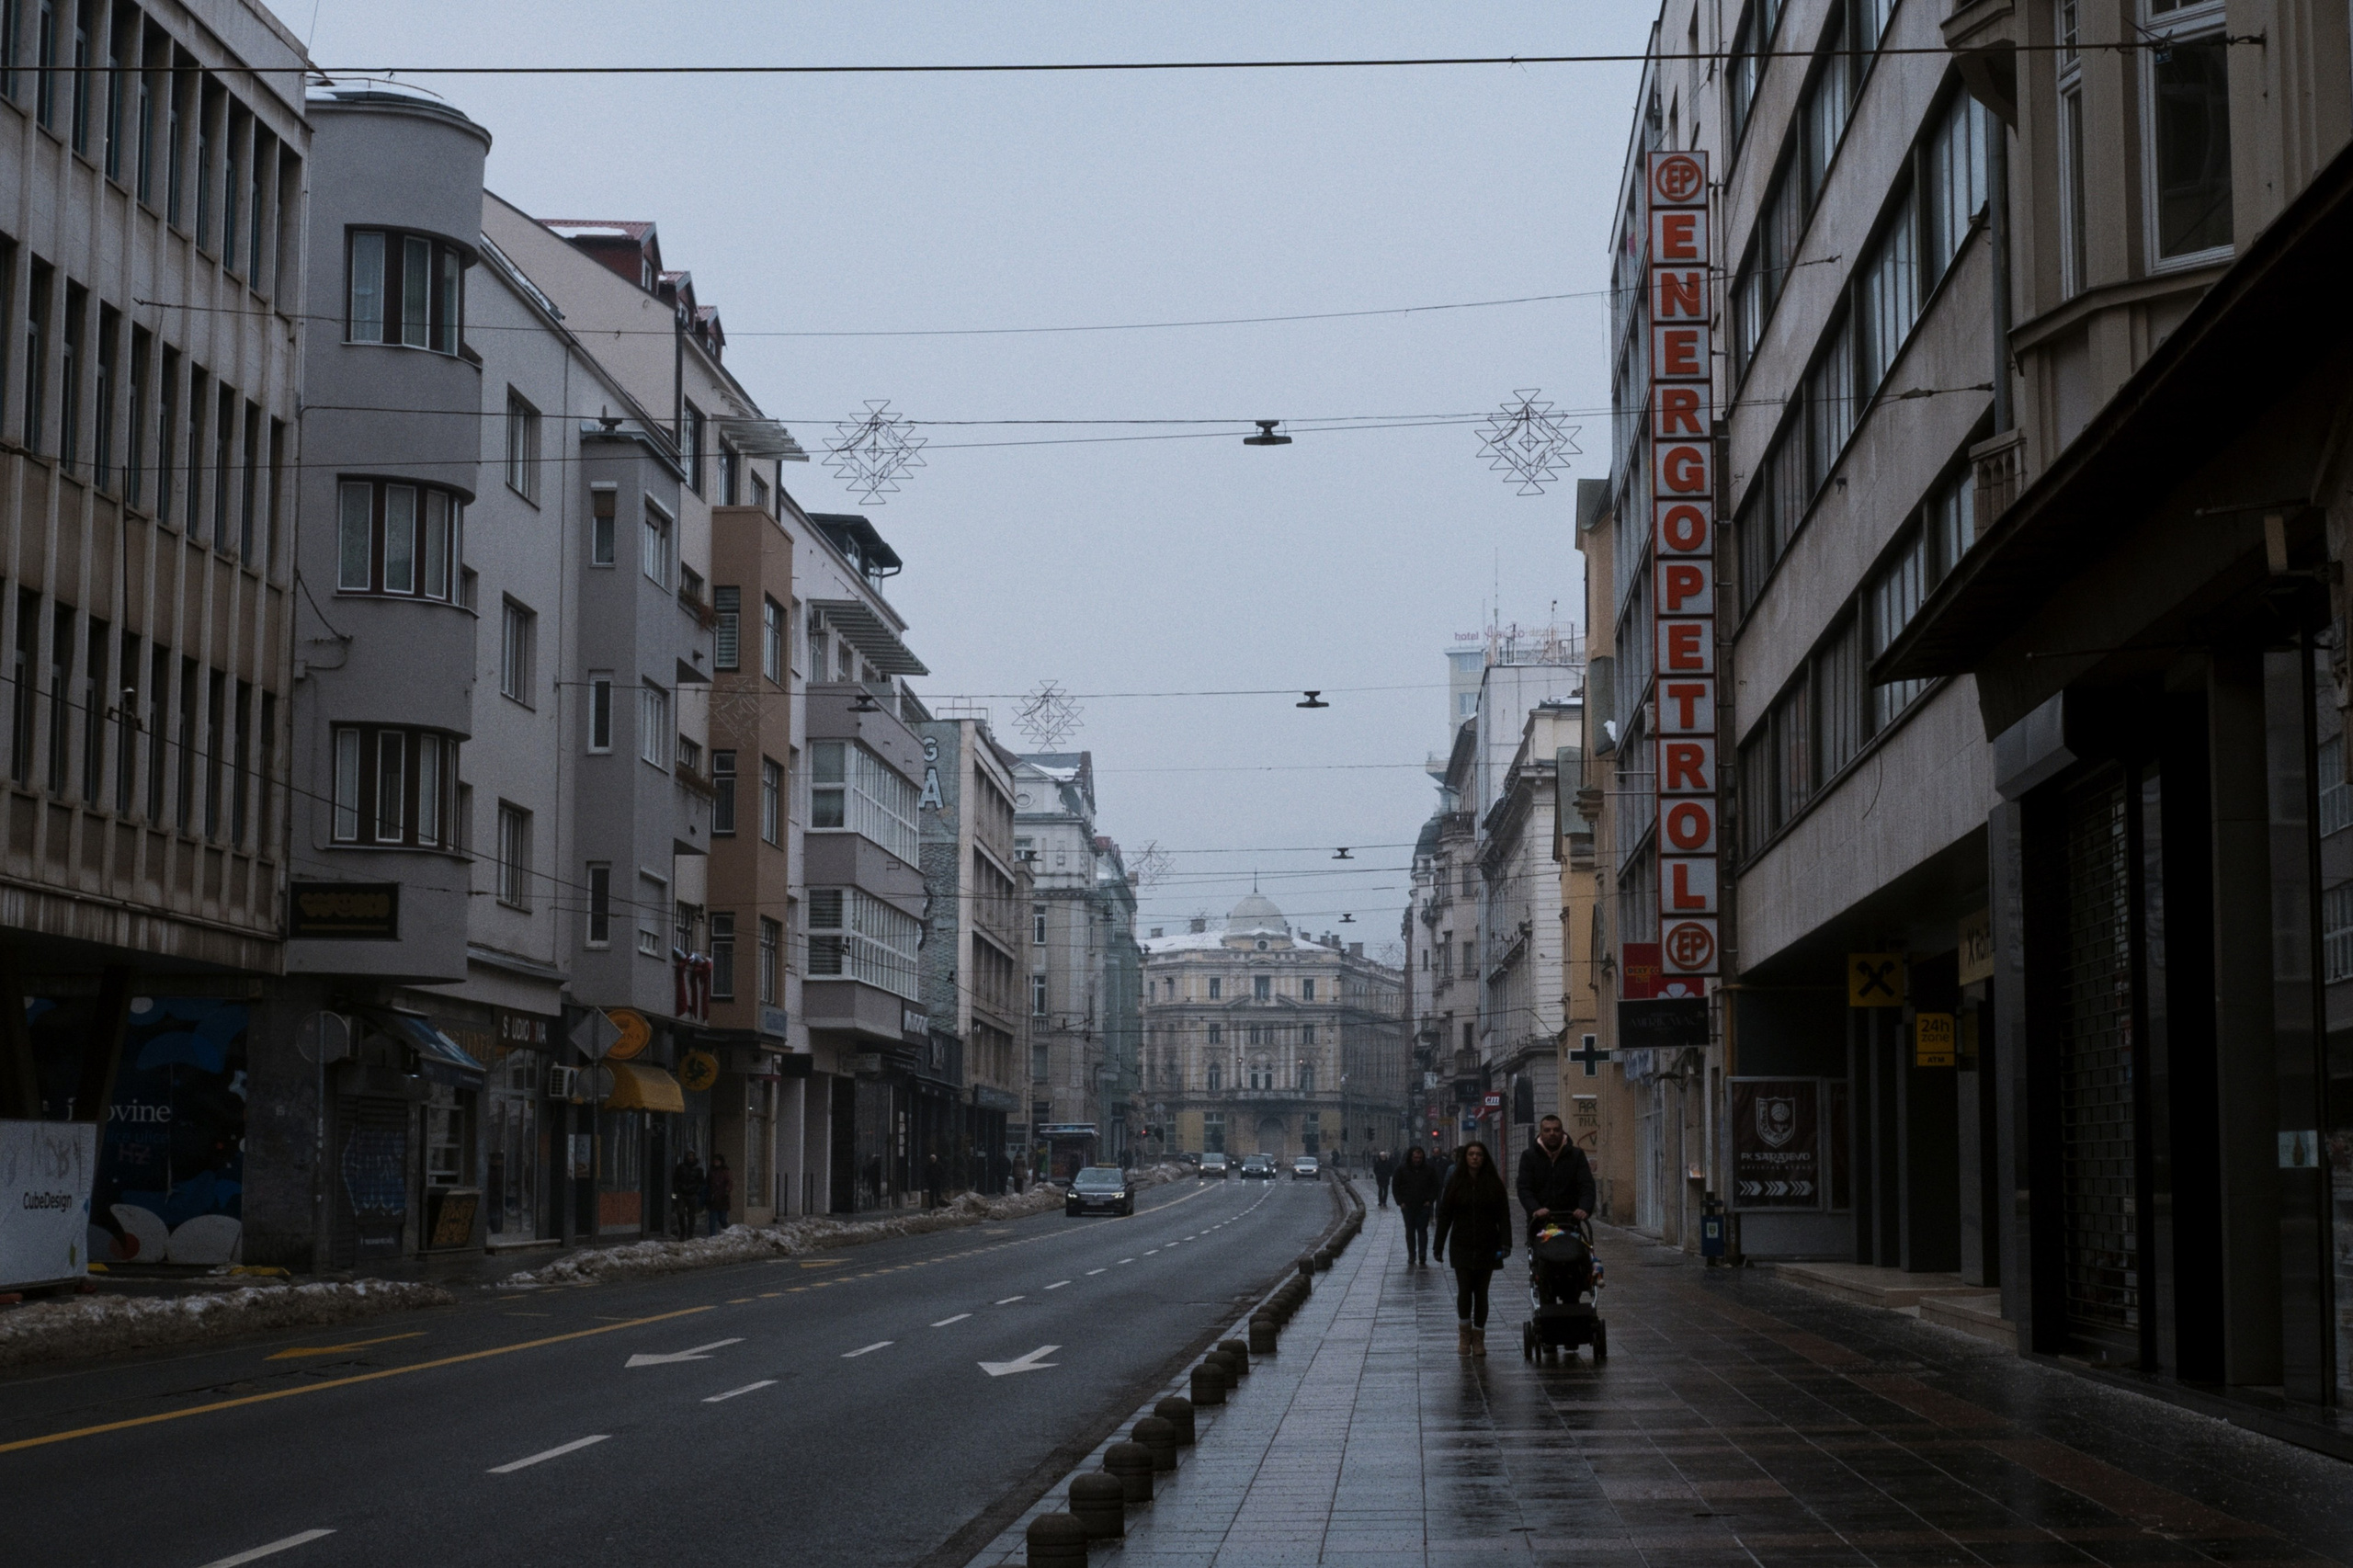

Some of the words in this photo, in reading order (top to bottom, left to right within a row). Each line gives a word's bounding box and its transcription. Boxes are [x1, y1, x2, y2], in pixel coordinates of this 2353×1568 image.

[1660, 214, 1710, 908] ENERGOPETROL
[1454, 632, 1479, 641] hotel
[1677, 932, 1707, 961] EP
[1921, 1019, 1949, 1032] 24h
[1921, 1033, 1949, 1042] zone
[1741, 1153, 1753, 1161] FK
[1754, 1152, 1811, 1164] SARAJEVO
[23, 1191, 73, 1212] CubeDesign
